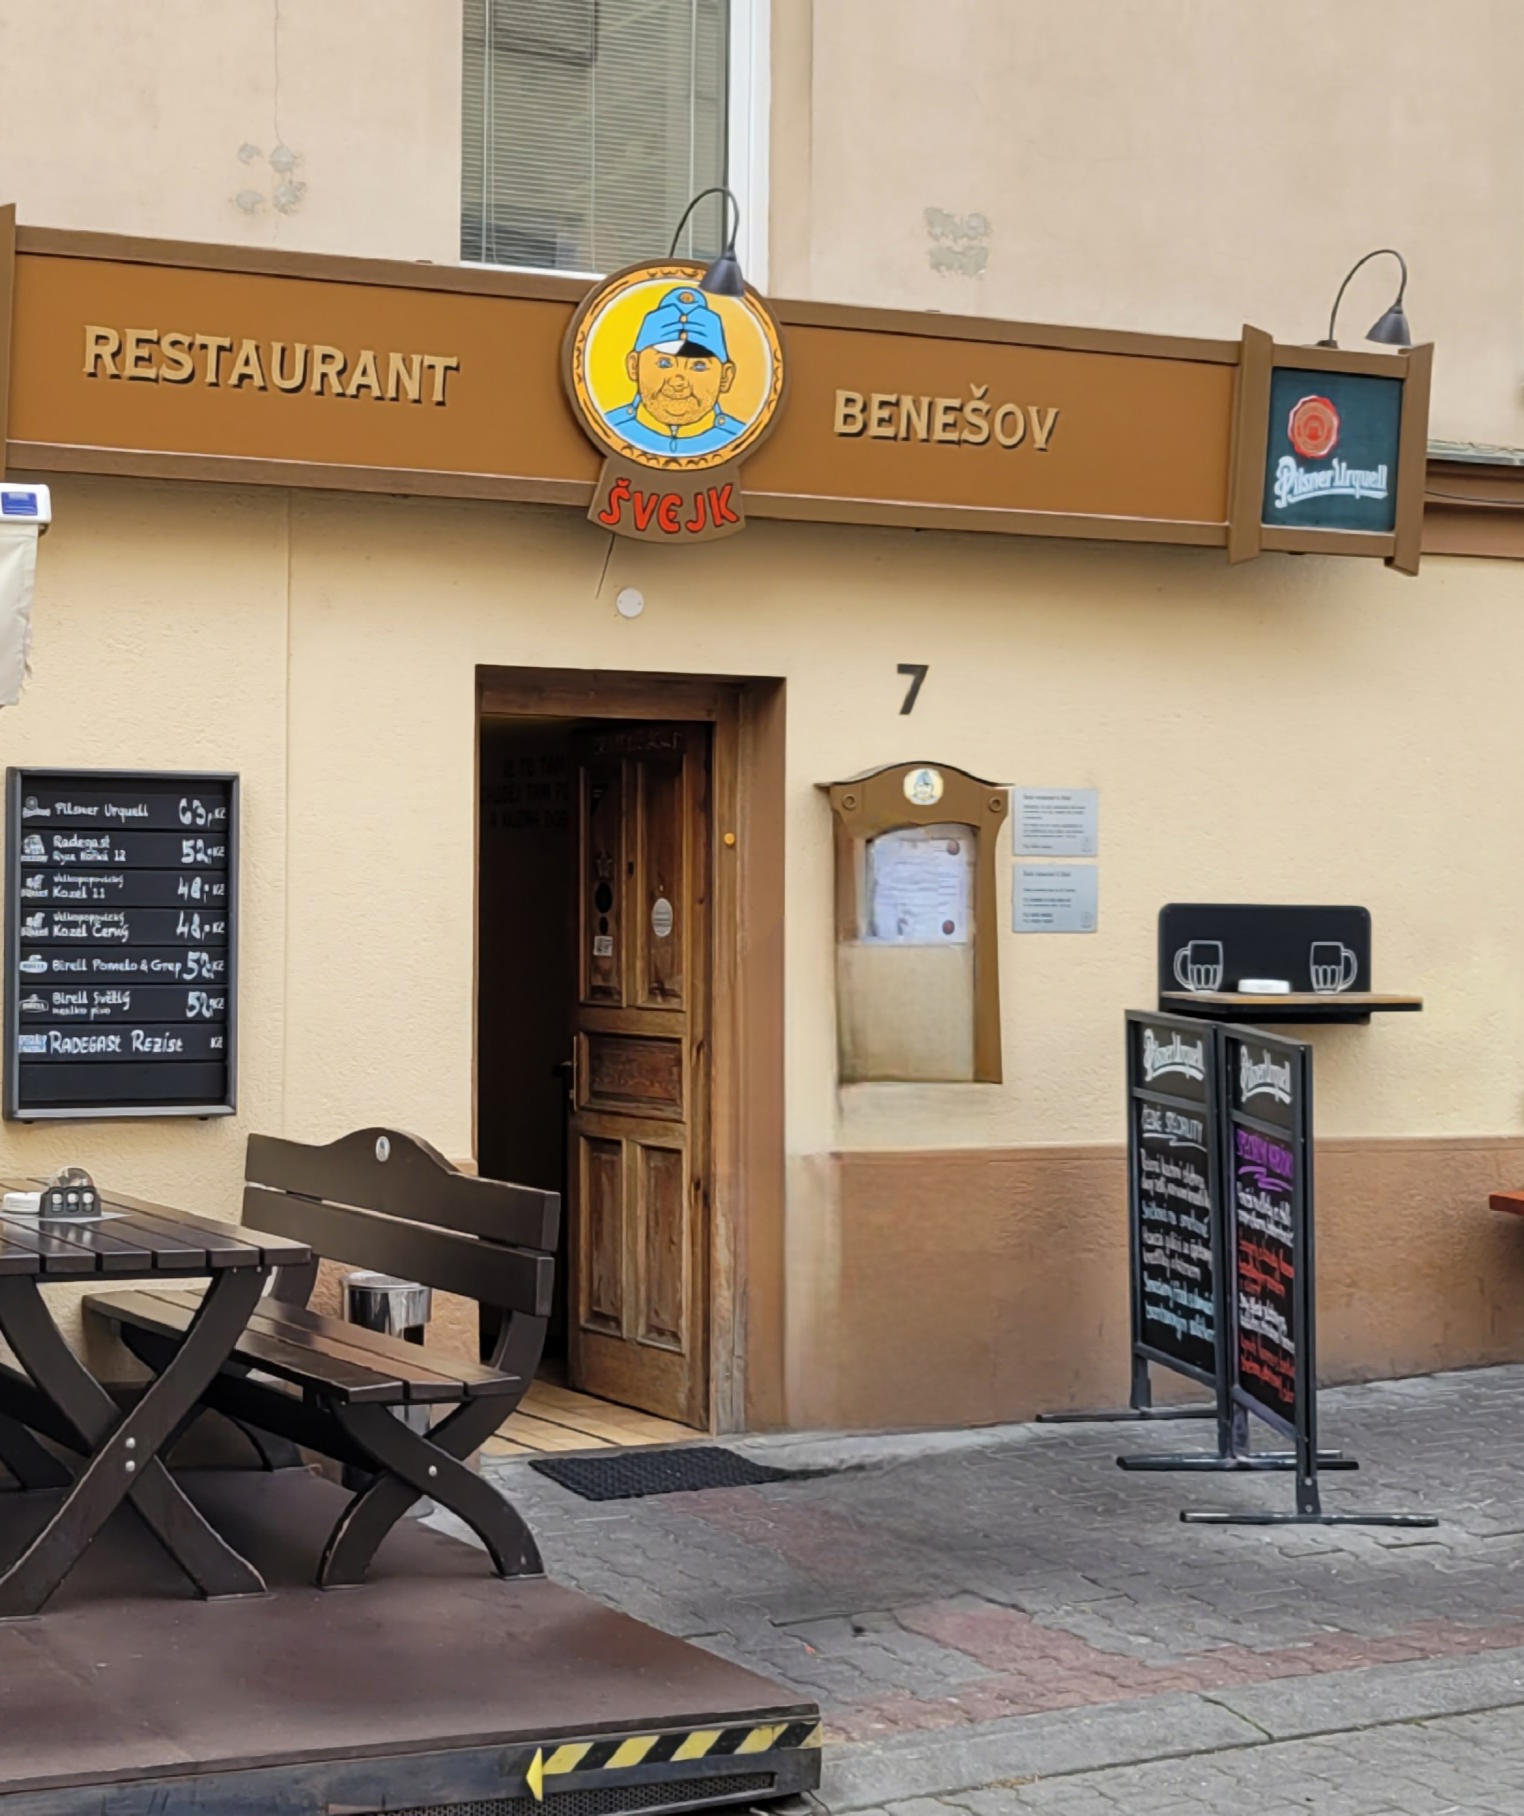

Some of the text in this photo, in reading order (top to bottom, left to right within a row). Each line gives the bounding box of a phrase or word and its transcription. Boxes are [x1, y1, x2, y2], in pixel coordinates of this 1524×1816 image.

[82, 324, 460, 407] RESTAURANT
[833, 383, 1059, 451] BENEŠOV
[1274, 455, 1388, 508] Pilsner Urquell
[598, 476, 740, 534] ŠVEJK
[897, 663, 929, 715] 7
[54, 803, 99, 816] Pilsner
[104, 804, 149, 823] Urquell
[52, 834, 110, 852] Radegast
[52, 886, 87, 899] Kozel
[92, 887, 105, 899] 11
[52, 924, 87, 937] Kozel
[92, 920, 129, 942] Černý
[52, 959, 87, 972] Birell
[92, 959, 137, 971] Pomelo
[151, 960, 182, 979] Grep
[52, 991, 88, 1004] Birell
